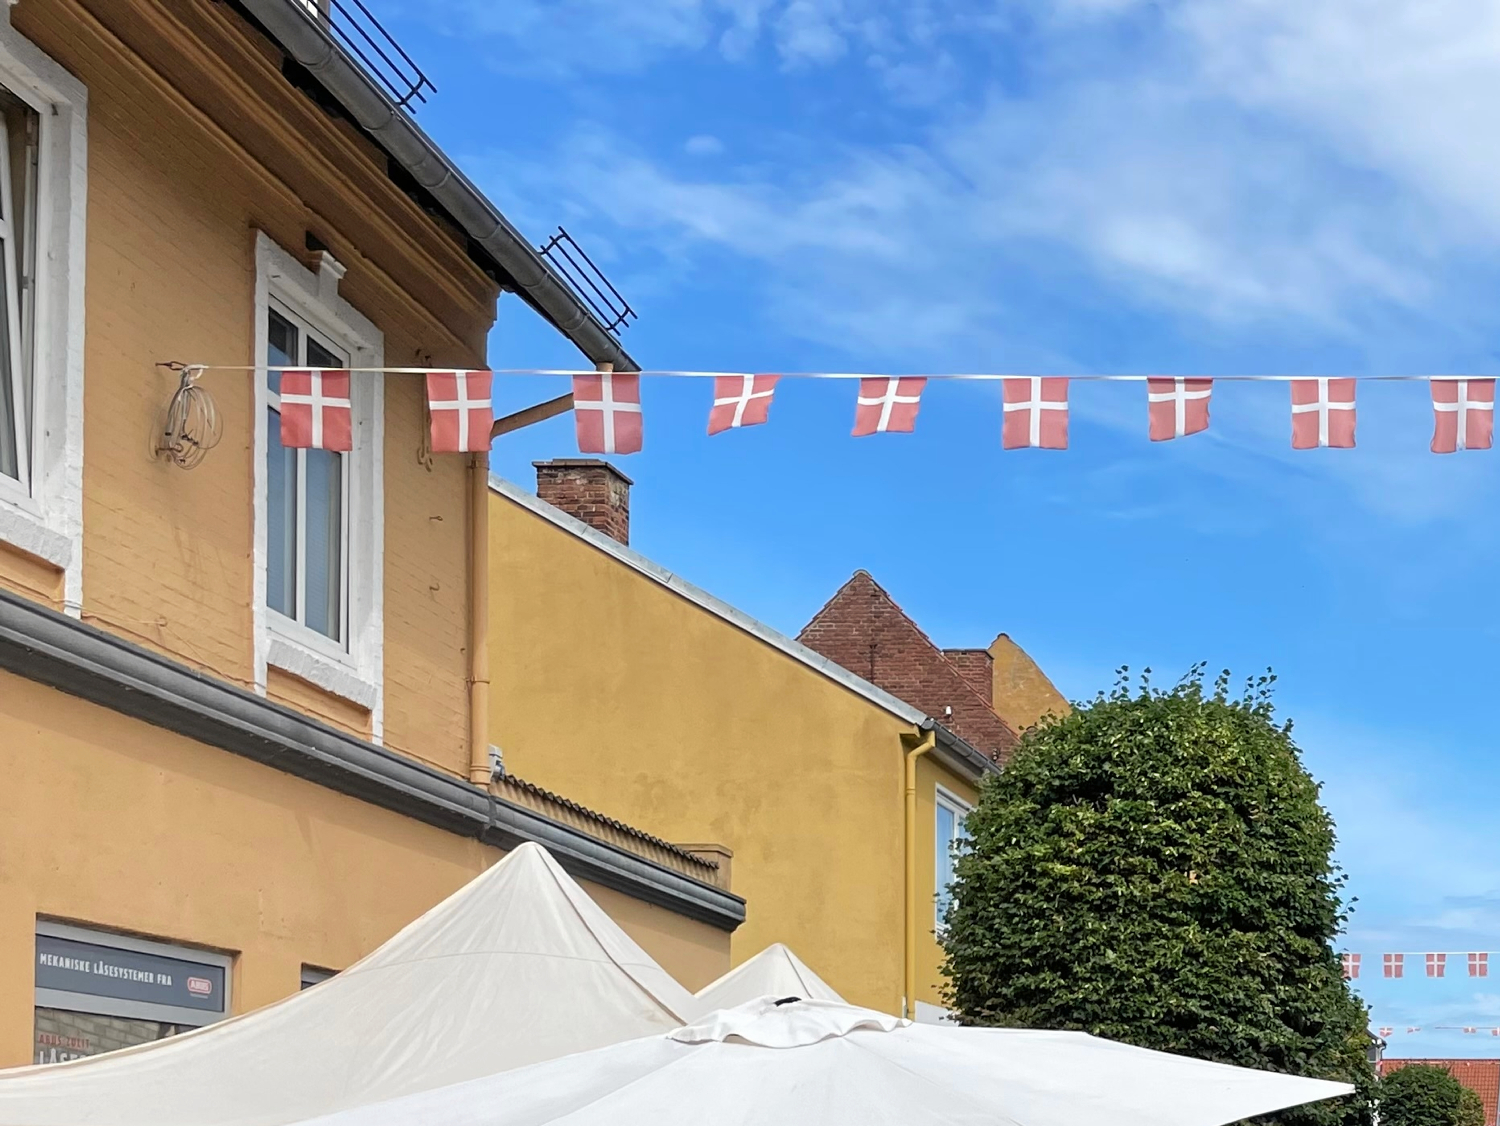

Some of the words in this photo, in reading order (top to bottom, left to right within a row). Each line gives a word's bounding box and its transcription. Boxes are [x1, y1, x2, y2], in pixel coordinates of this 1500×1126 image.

[39, 953, 90, 973] MEKANISKE
[94, 961, 154, 983] LÅSESYSTEMER
[157, 974, 172, 986] FRA
